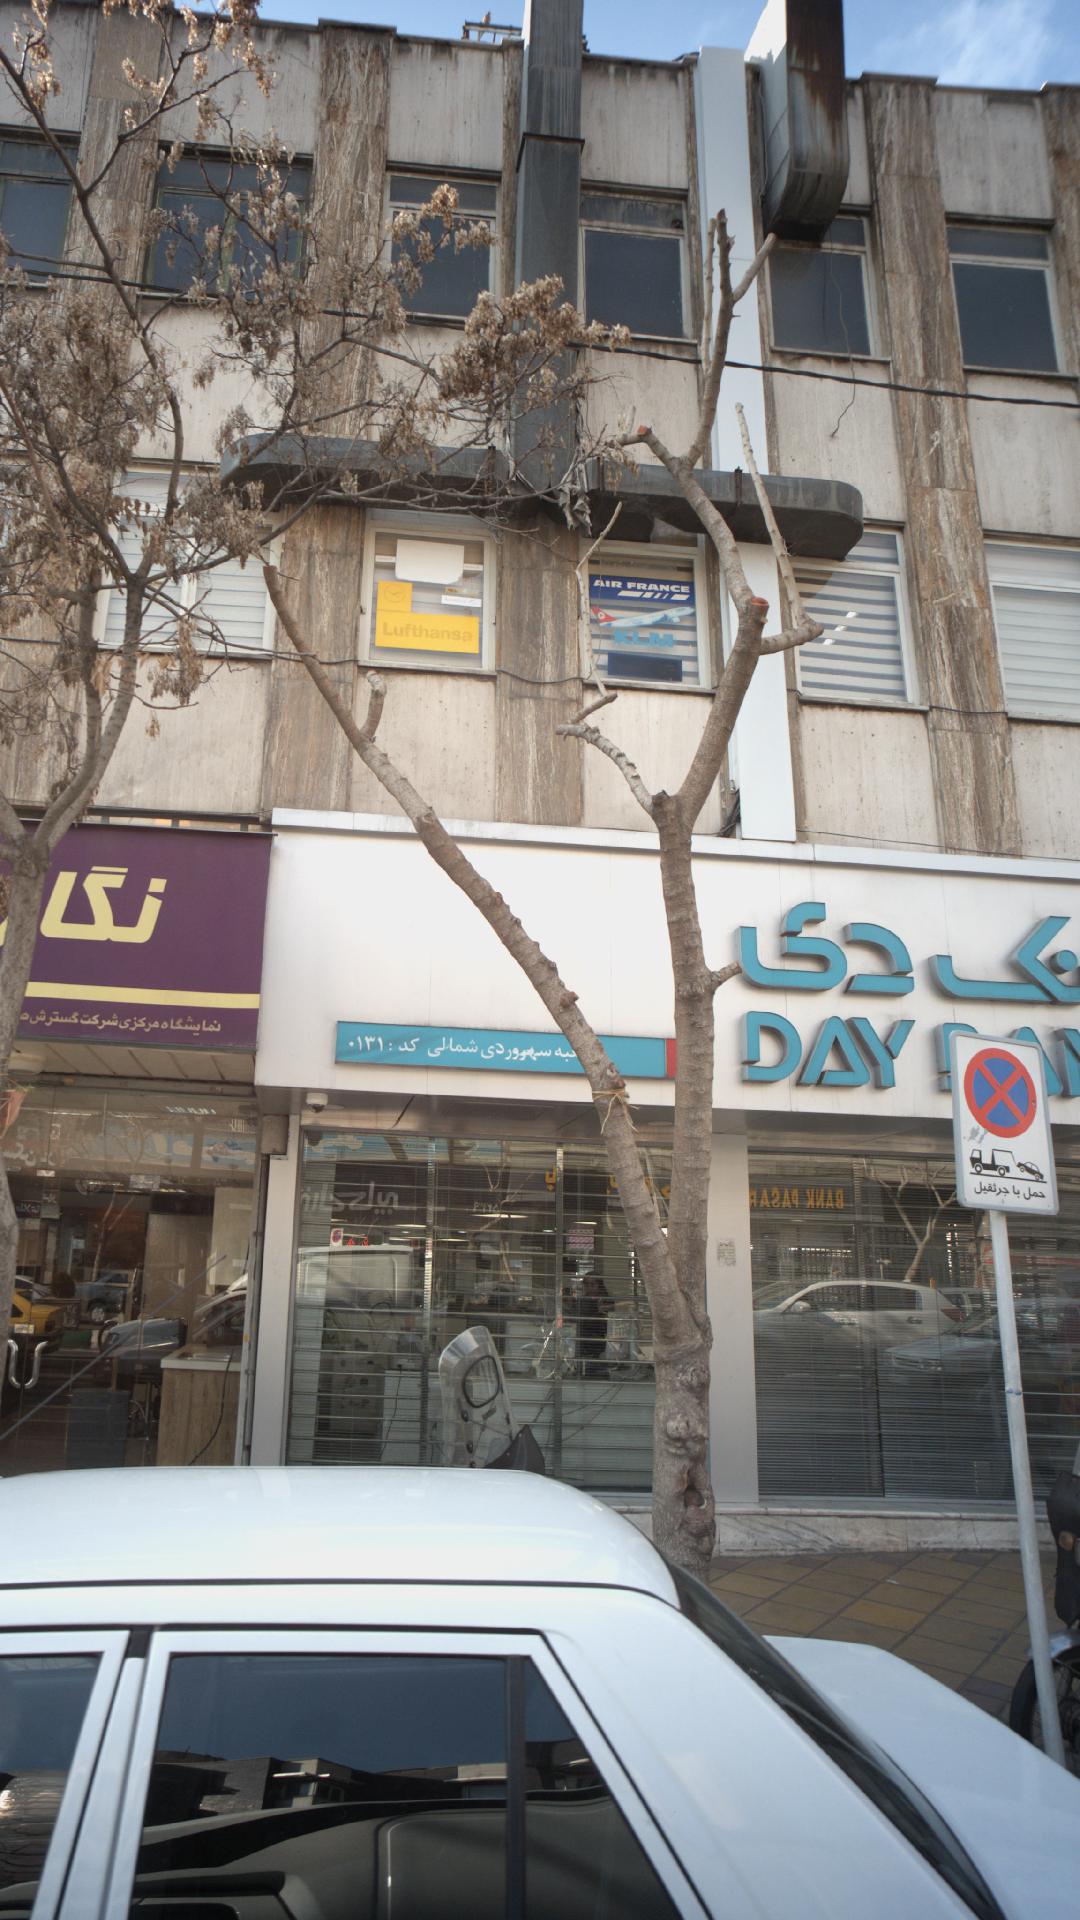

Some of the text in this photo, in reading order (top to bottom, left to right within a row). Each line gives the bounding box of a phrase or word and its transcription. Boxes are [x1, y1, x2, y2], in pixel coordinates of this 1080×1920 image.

[593, 578, 691, 593] AIR FRANCE
[382, 621, 474, 643] Lufthansa
[613, 628, 675, 648] KLM
[735, 901, 915, 996] دی
[29, 1009, 80, 1027] گسترش
[80, 1012, 119, 1030] شرکت
[118, 1016, 160, 1033] مرکزی
[160, 1015, 222, 1037] نمایشگاه
[427, 1036, 479, 1058] شمالی
[741, 1010, 916, 1089] DAY
[973, 1180, 1047, 1201] حمل با جرثقیل
